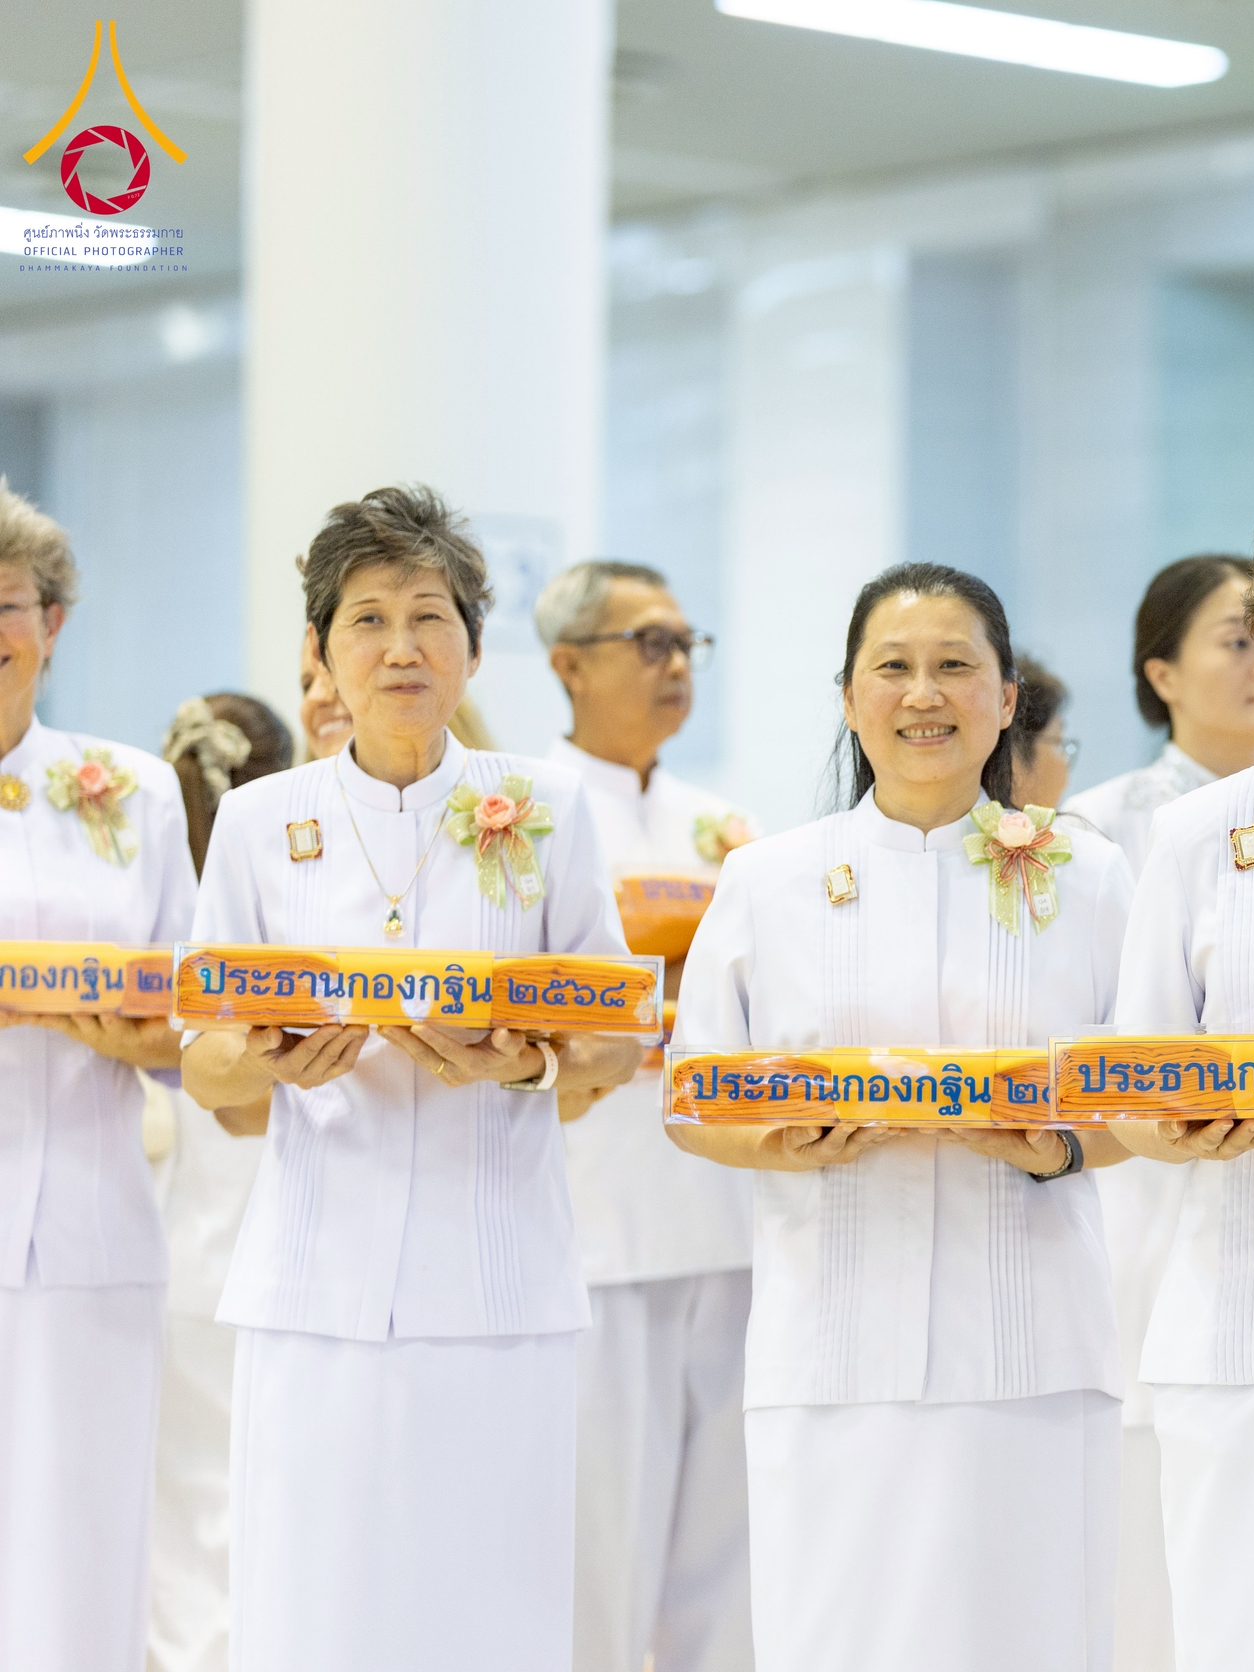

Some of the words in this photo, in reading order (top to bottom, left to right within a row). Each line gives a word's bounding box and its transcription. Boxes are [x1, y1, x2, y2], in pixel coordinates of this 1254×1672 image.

[199, 961, 493, 1014] ประธานกองกฐิน
[507, 978, 626, 1007] ๒๕๖๘
[691, 1063, 991, 1116] ประธานกองกฐิน
